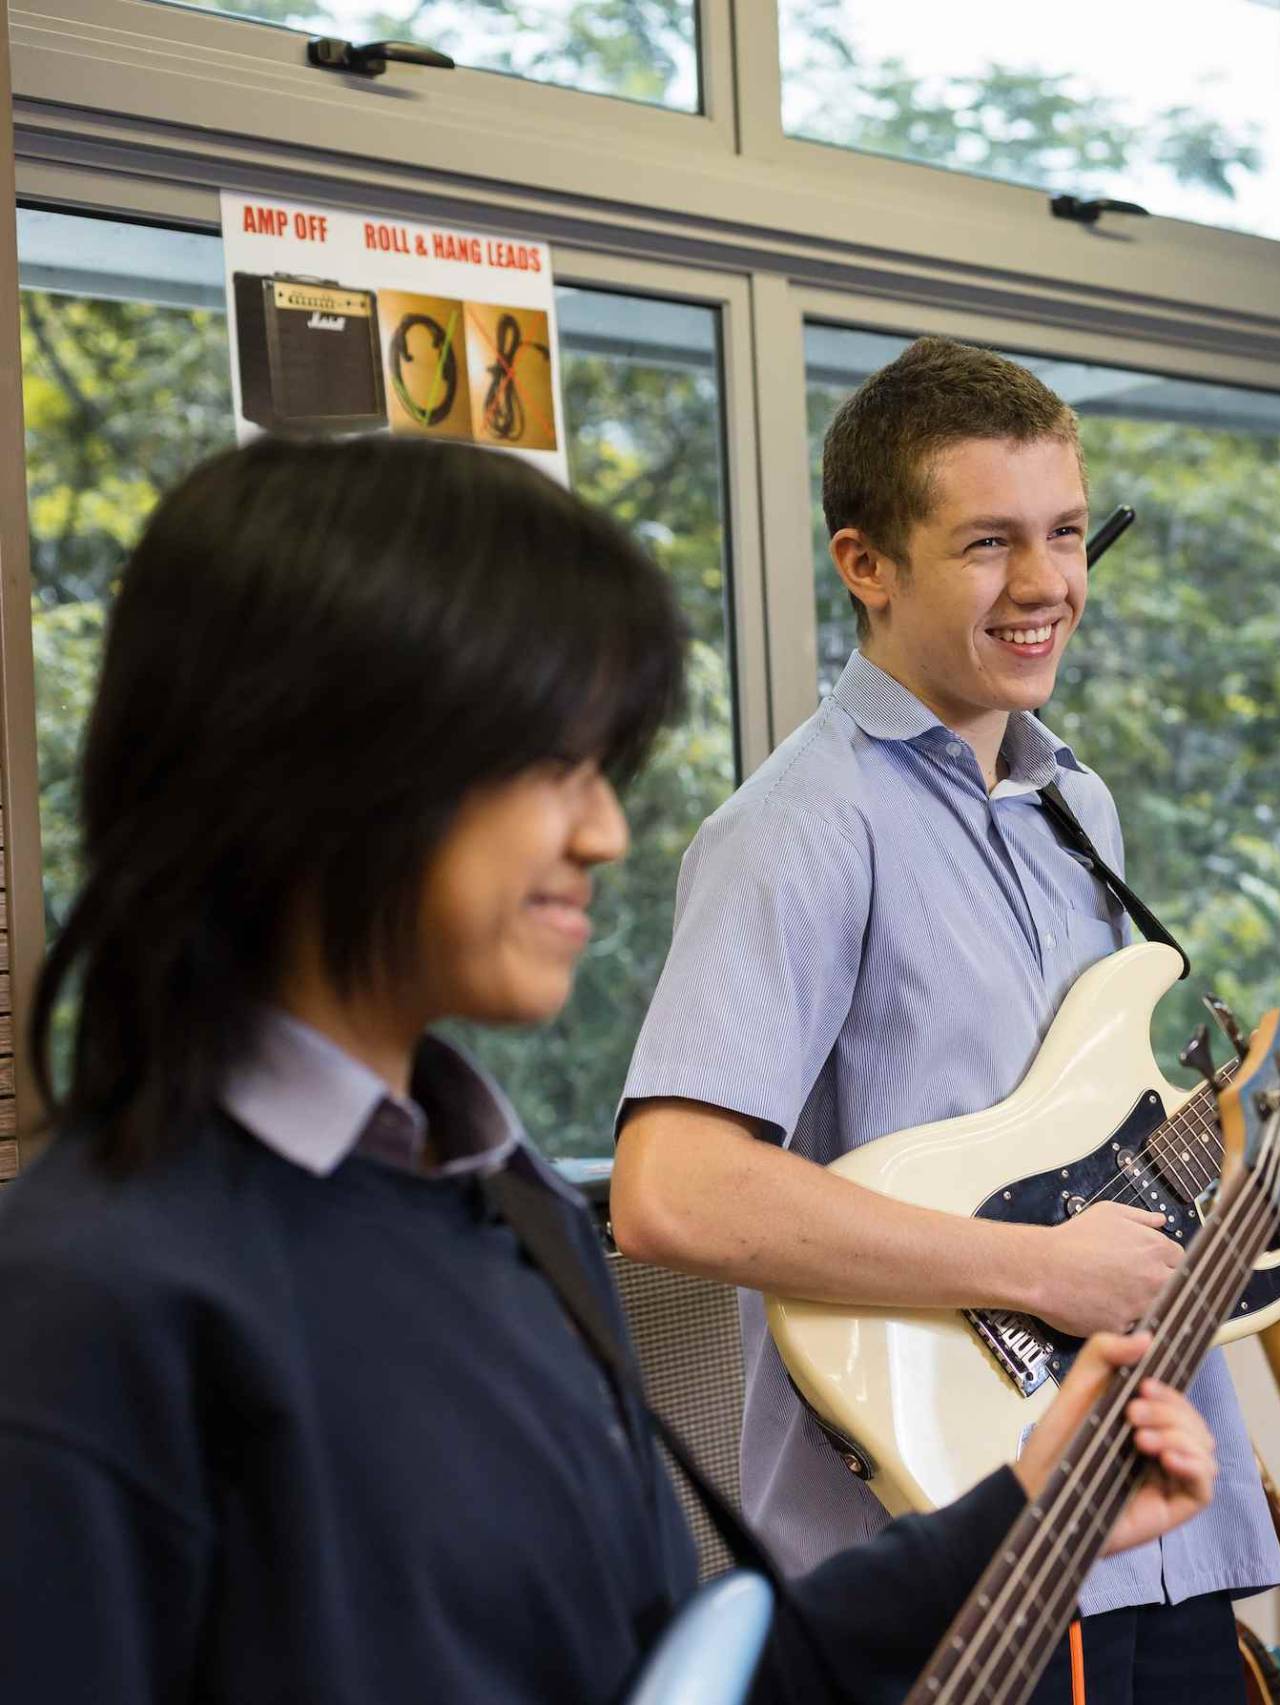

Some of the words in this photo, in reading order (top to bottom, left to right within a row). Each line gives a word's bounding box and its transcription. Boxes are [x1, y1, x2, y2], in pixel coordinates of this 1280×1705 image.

[244, 205, 288, 237] AMP
[294, 213, 328, 243] OFF
[364, 223, 410, 254] ROLL
[415, 234, 428, 256] &
[433, 234, 482, 264] HANG
[487, 242, 541, 273] LEADS
